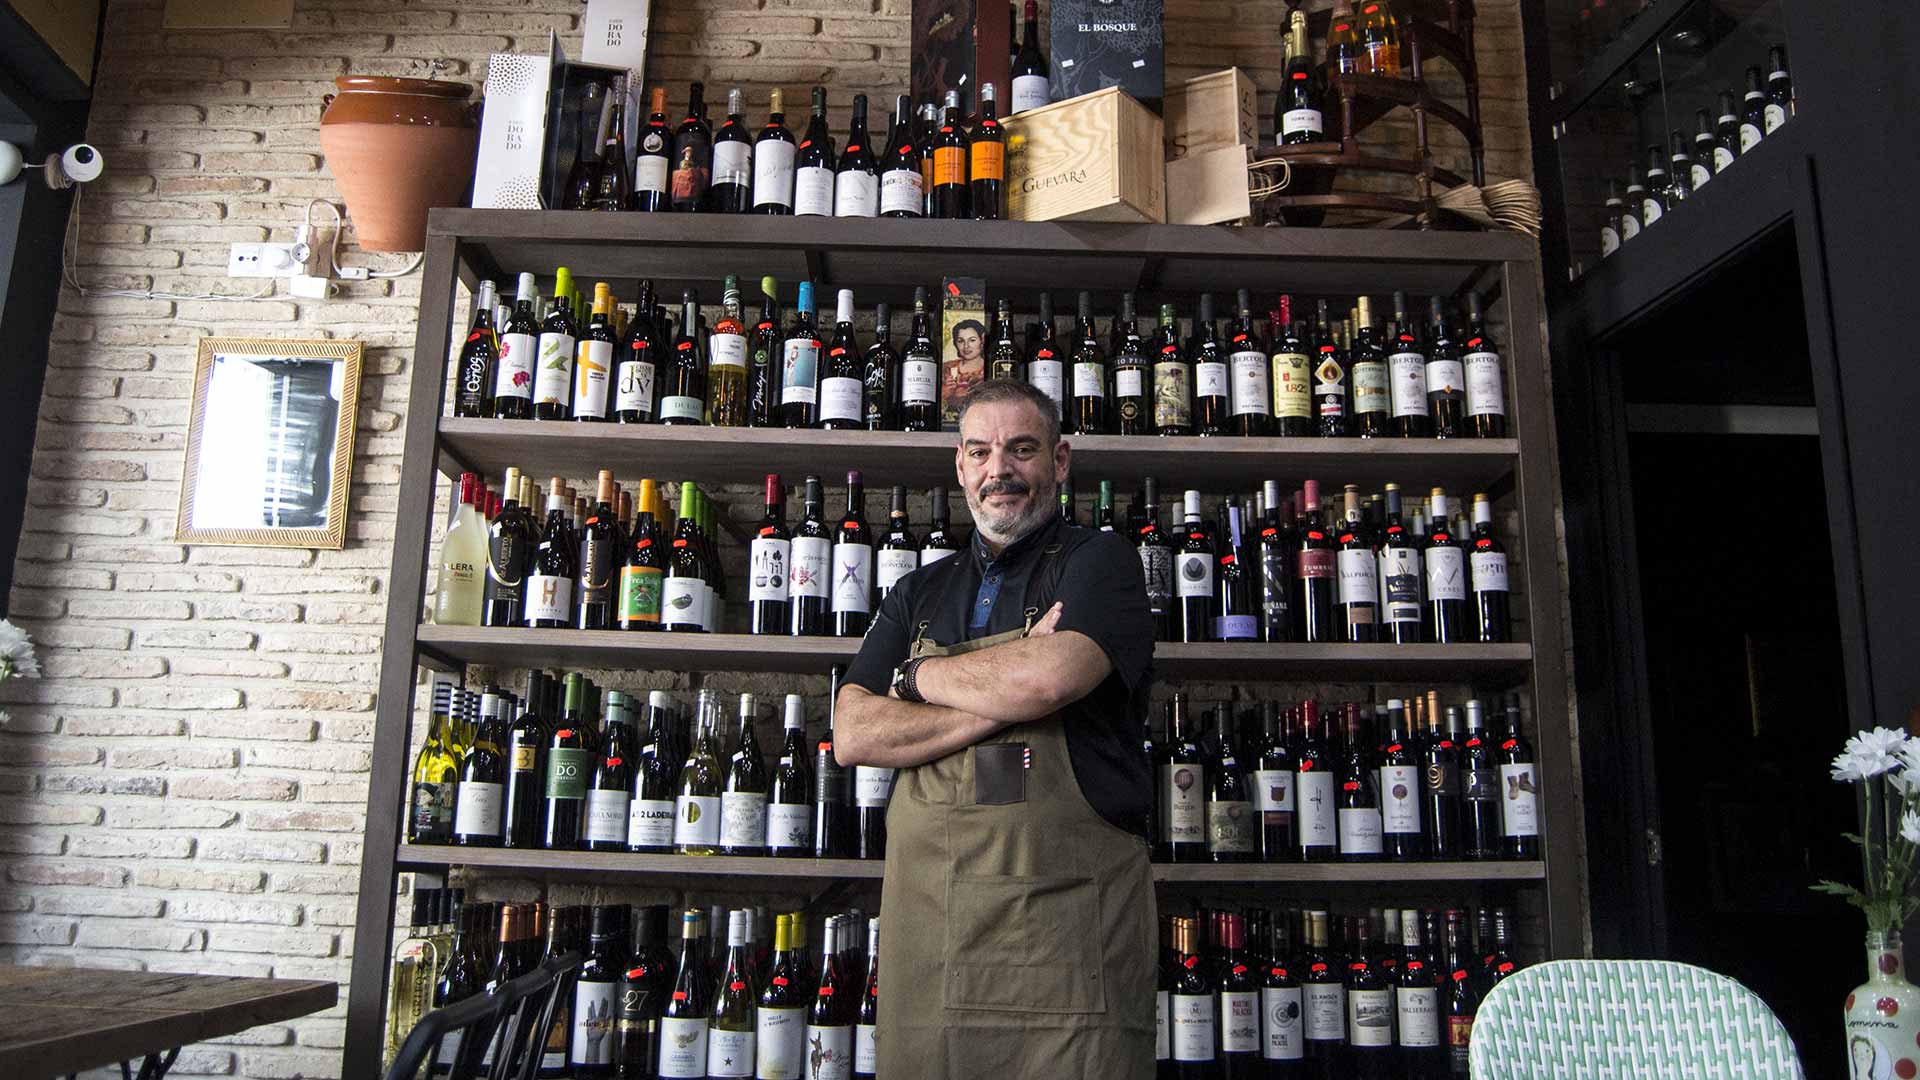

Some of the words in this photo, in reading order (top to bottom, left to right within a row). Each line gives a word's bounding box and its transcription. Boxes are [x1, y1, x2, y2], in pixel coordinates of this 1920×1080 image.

[1078, 24, 1091, 32] EL
[1093, 23, 1137, 33] BOSQUE
[556, 765, 577, 777] DO
[622, 990, 649, 1012] 27
